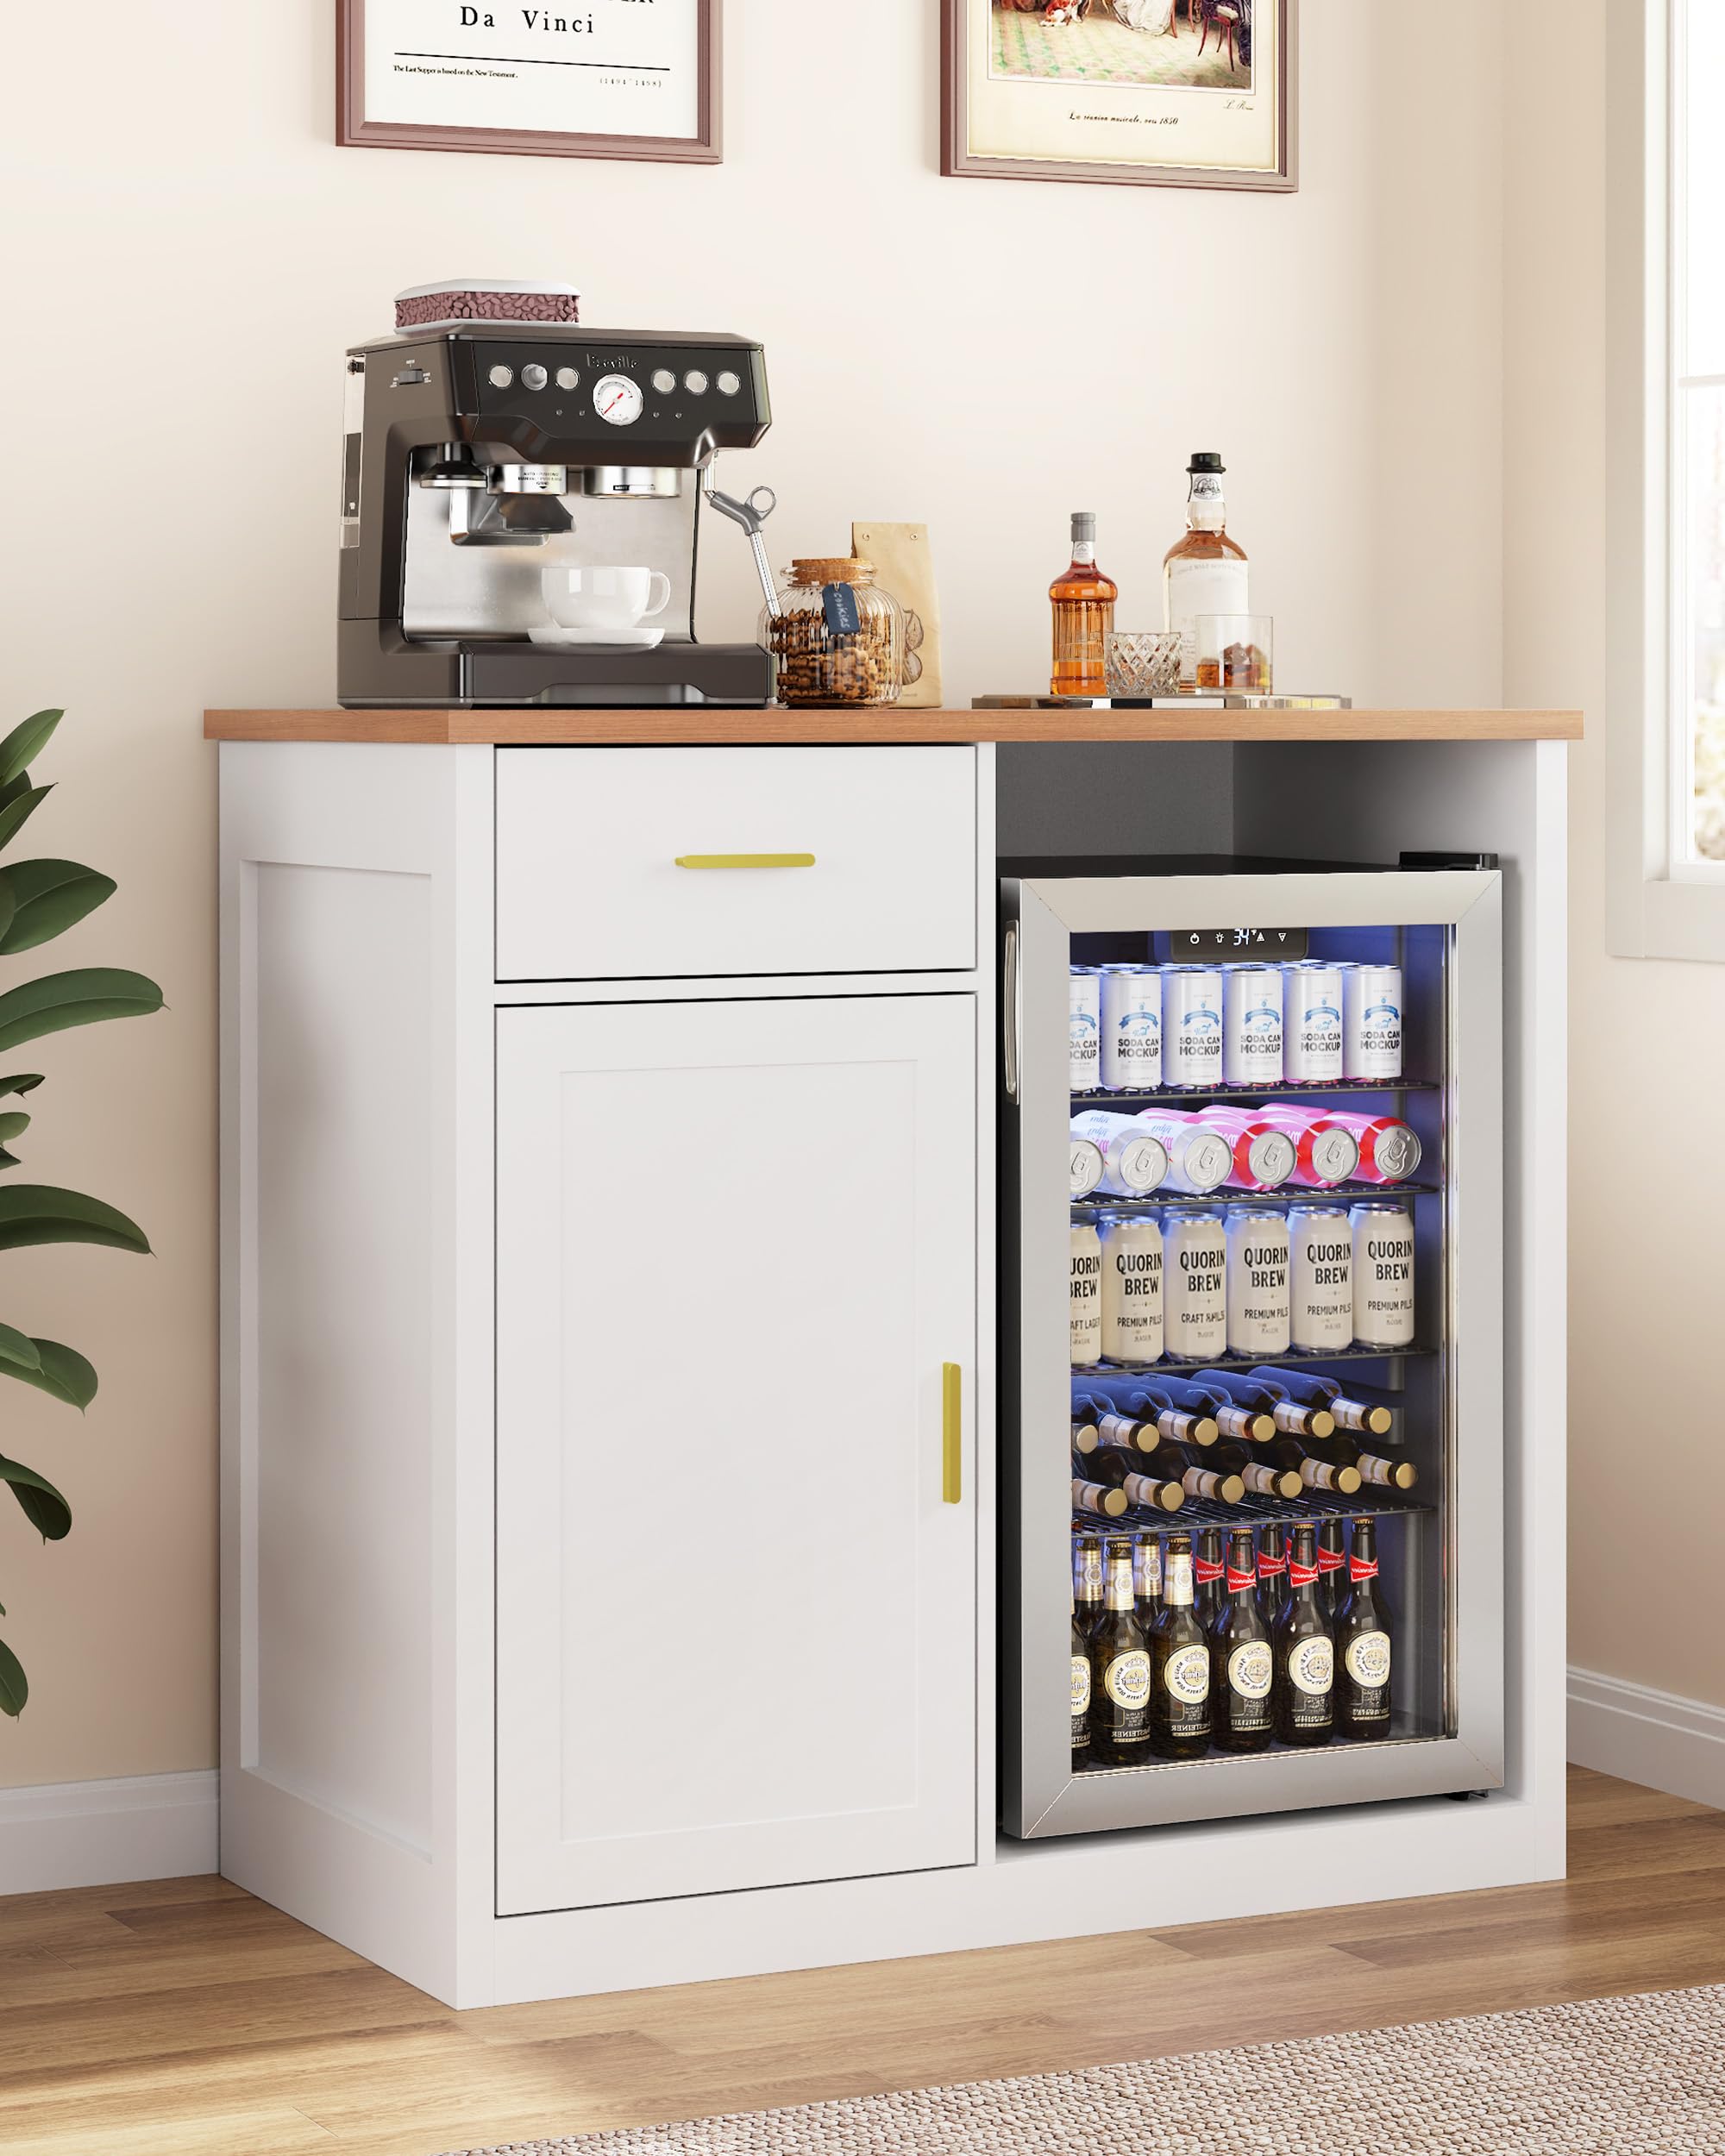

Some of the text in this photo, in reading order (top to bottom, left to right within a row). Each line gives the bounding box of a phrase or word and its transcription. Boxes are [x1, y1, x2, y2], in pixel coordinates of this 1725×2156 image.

[460, 6, 593, 33] Da Vinci
[1233, 928, 1249, 946] 34
[1070, 1040, 1097, 1049] DA CAN
[1118, 1038, 1159, 1047] SODA CAN
[1179, 1037, 1205, 1045] SODA
[1301, 1042, 1341, 1052] MOCKUP
[1360, 1039, 1400, 1050] MOCKUP
[1070, 1050, 1097, 1060] CKUP
[1118, 1048, 1159, 1057] MOCKUP
[1179, 1045, 1220, 1056] MOCKUP
[1240, 1044, 1281, 1054] MOCKUP
[1308, 1242, 1352, 1264] QUORIN
[1368, 1239, 1413, 1261] QUORIN
[1180, 1249, 1226, 1271] QUORIN
[1244, 1245, 1289, 1268] QUORIN
[1070, 1256, 1101, 1275] UORIN
[1116, 1252, 1163, 1275] QUORIN
[1315, 1266, 1348, 1284] BREW
[1376, 1263, 1409, 1281] BREW
[1188, 1273, 1222, 1292] BREW
[1251, 1269, 1286, 1288] BREW
[1125, 1276, 1159, 1295] BREW
[1308, 1303, 1352, 1315] PREMIUM PILS
[1368, 1299, 1413, 1311] PREMIUM PILS
[1181, 1313, 1204, 1324] CRAFT
[1244, 1307, 1289, 1319] PREMIUM PILS
[1070, 1319, 1084, 1330] AFT
[1117, 1314, 1163, 1327] PREMIUM PILS
